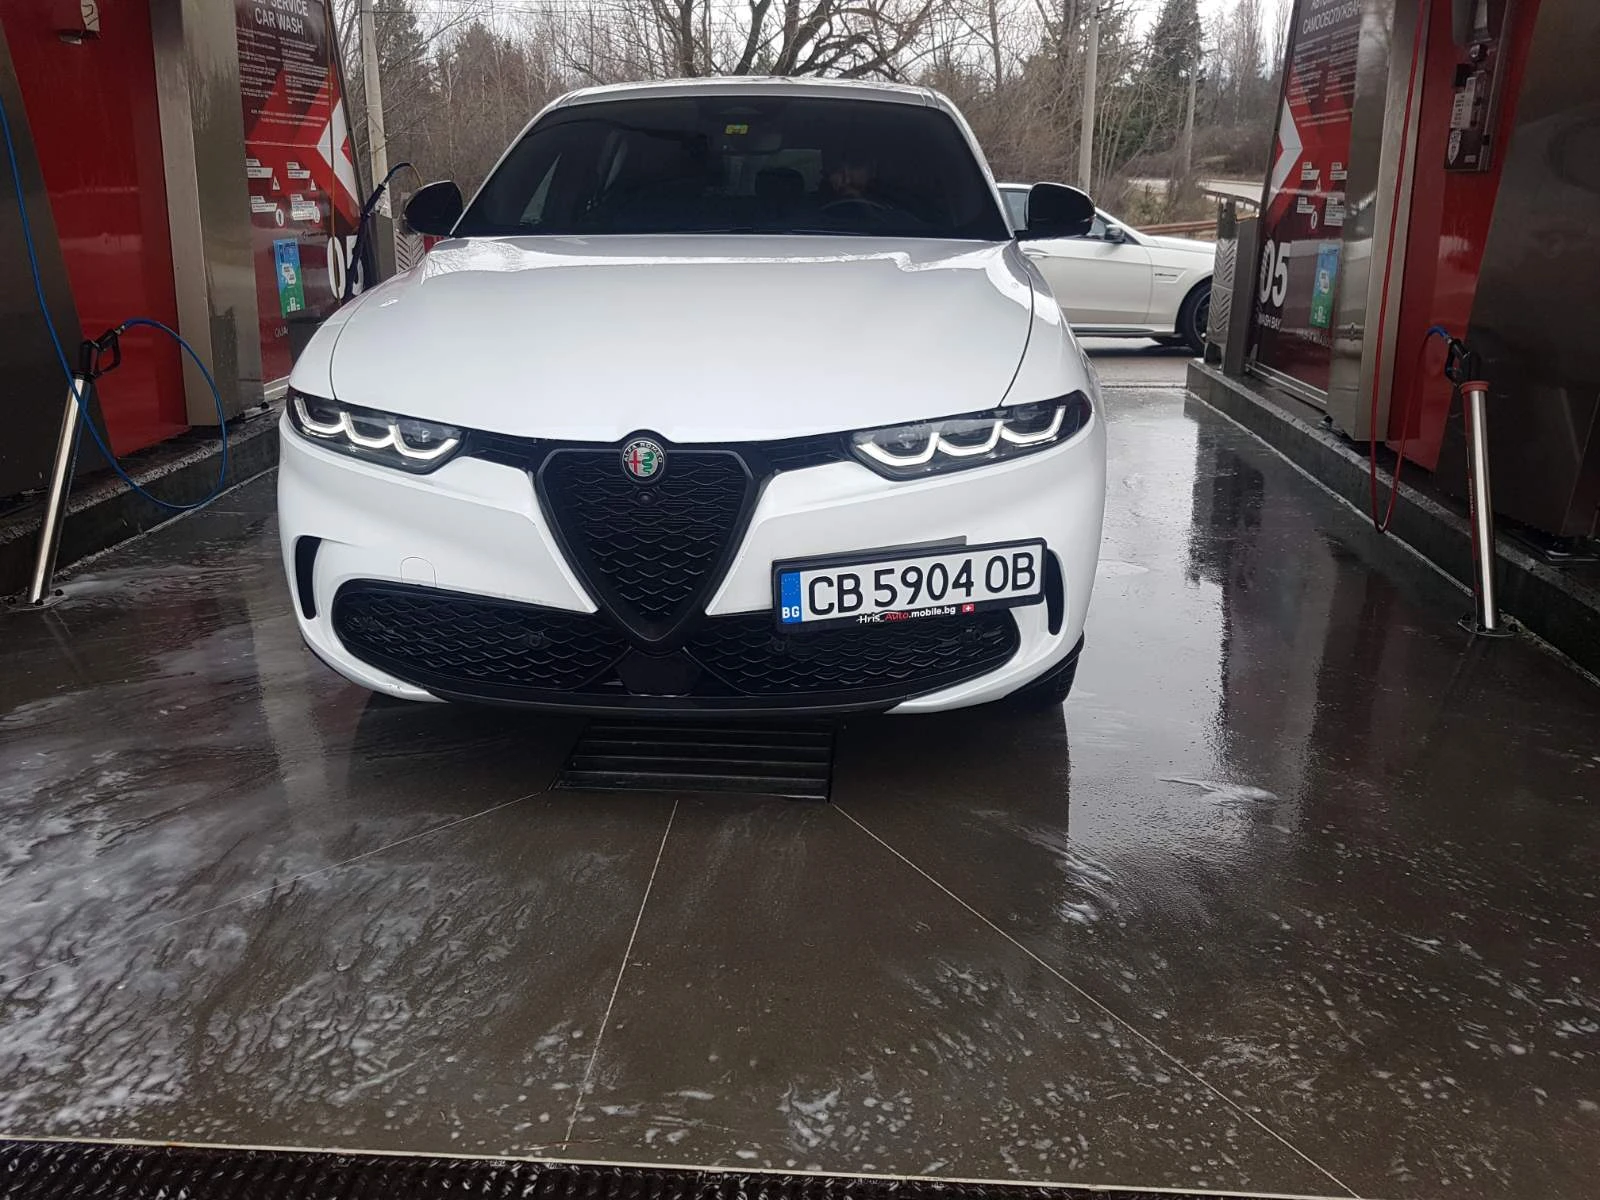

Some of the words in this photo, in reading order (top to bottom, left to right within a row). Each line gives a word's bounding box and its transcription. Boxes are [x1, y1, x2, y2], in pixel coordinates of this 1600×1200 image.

[255, 7, 277, 28] CAR
[276, 13, 304, 35] WASH
[270, 0, 309, 16] SERVICE
[1259, 239, 1291, 307] 05
[807, 572, 864, 615] CB
[873, 558, 975, 608] 5904
[781, 605, 800, 618] BG
